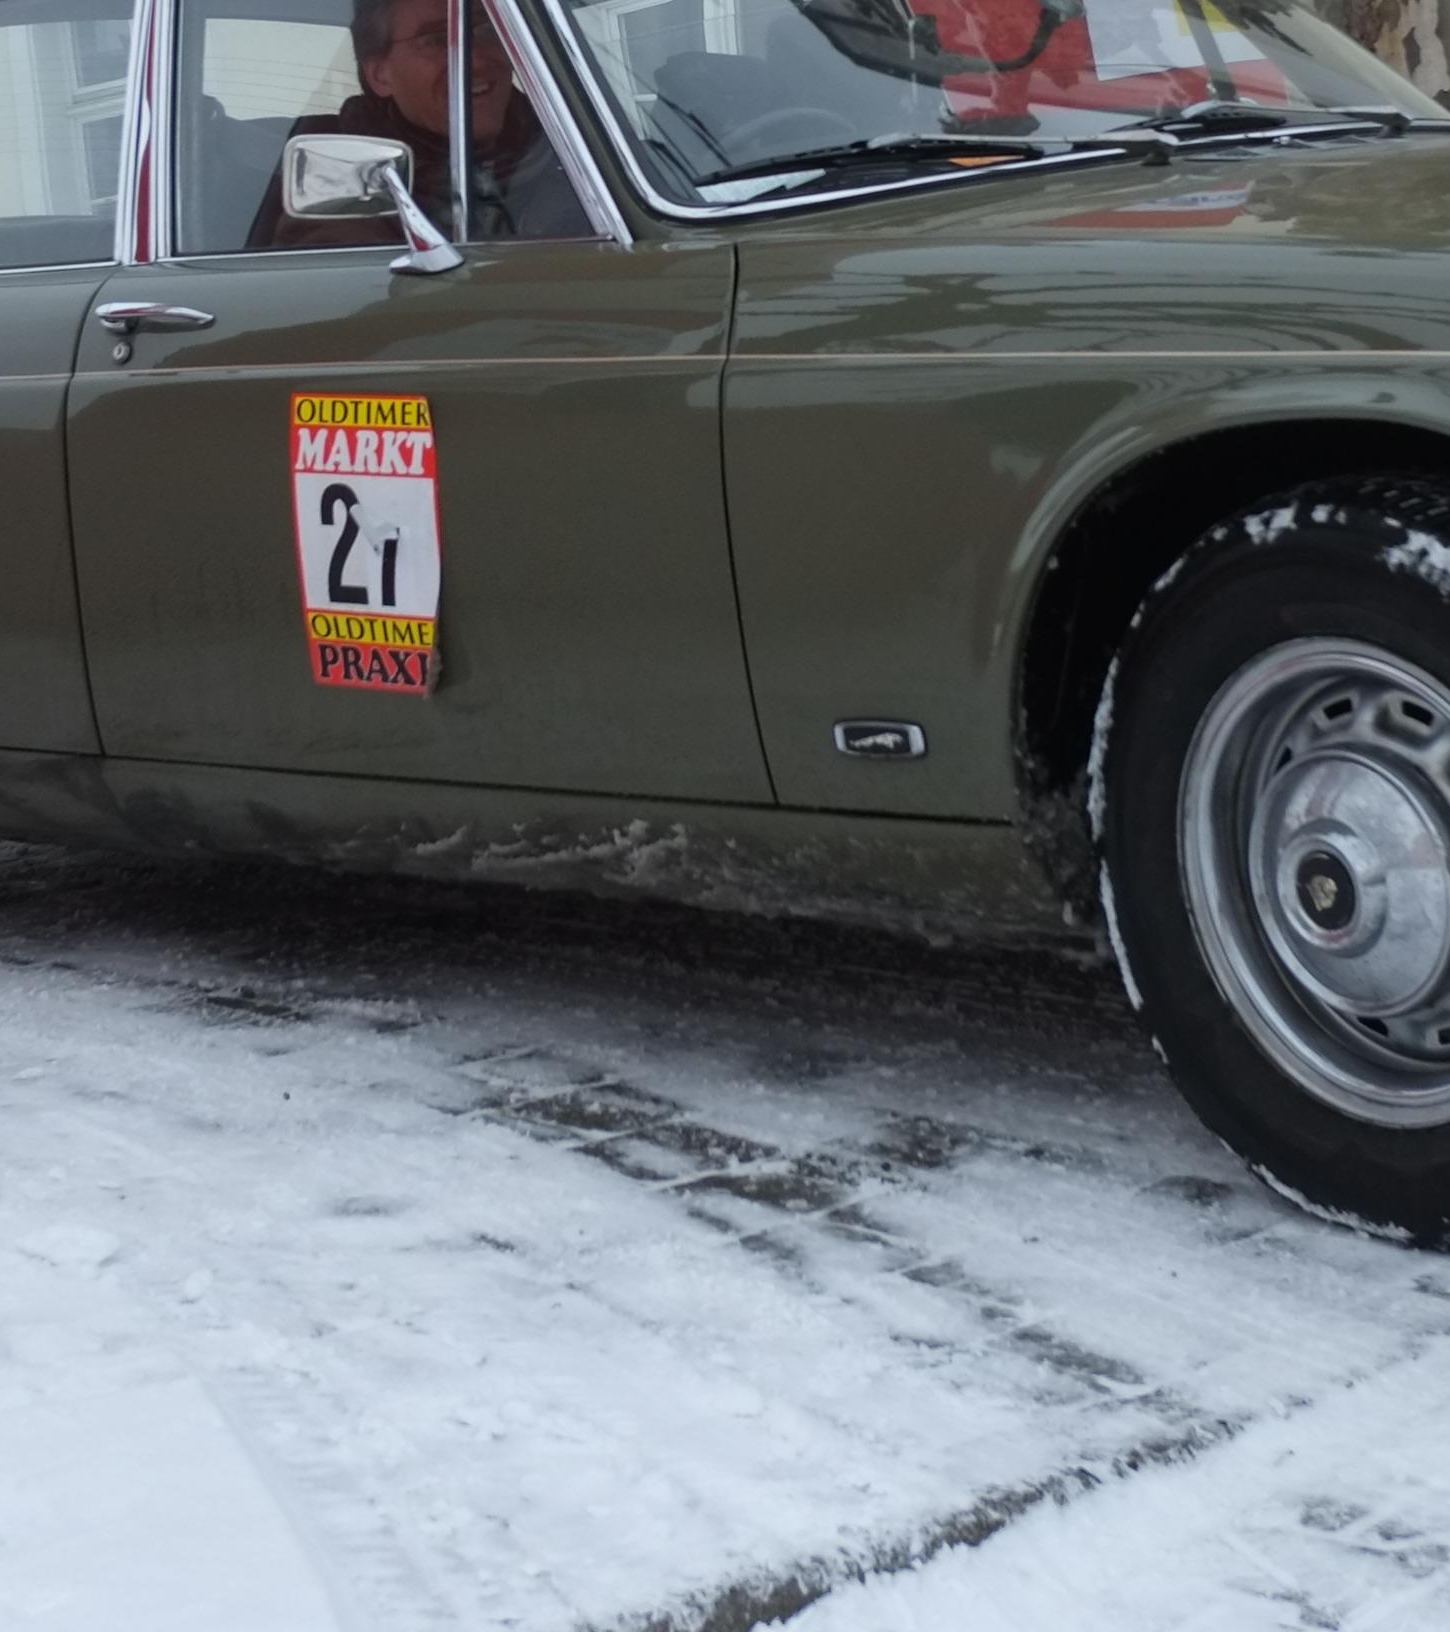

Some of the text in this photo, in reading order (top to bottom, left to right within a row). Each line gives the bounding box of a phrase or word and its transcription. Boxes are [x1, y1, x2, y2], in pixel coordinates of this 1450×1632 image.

[297, 398, 430, 426] OLDTIMER
[295, 428, 431, 475] MARKT
[311, 614, 435, 647] OLDTIME
